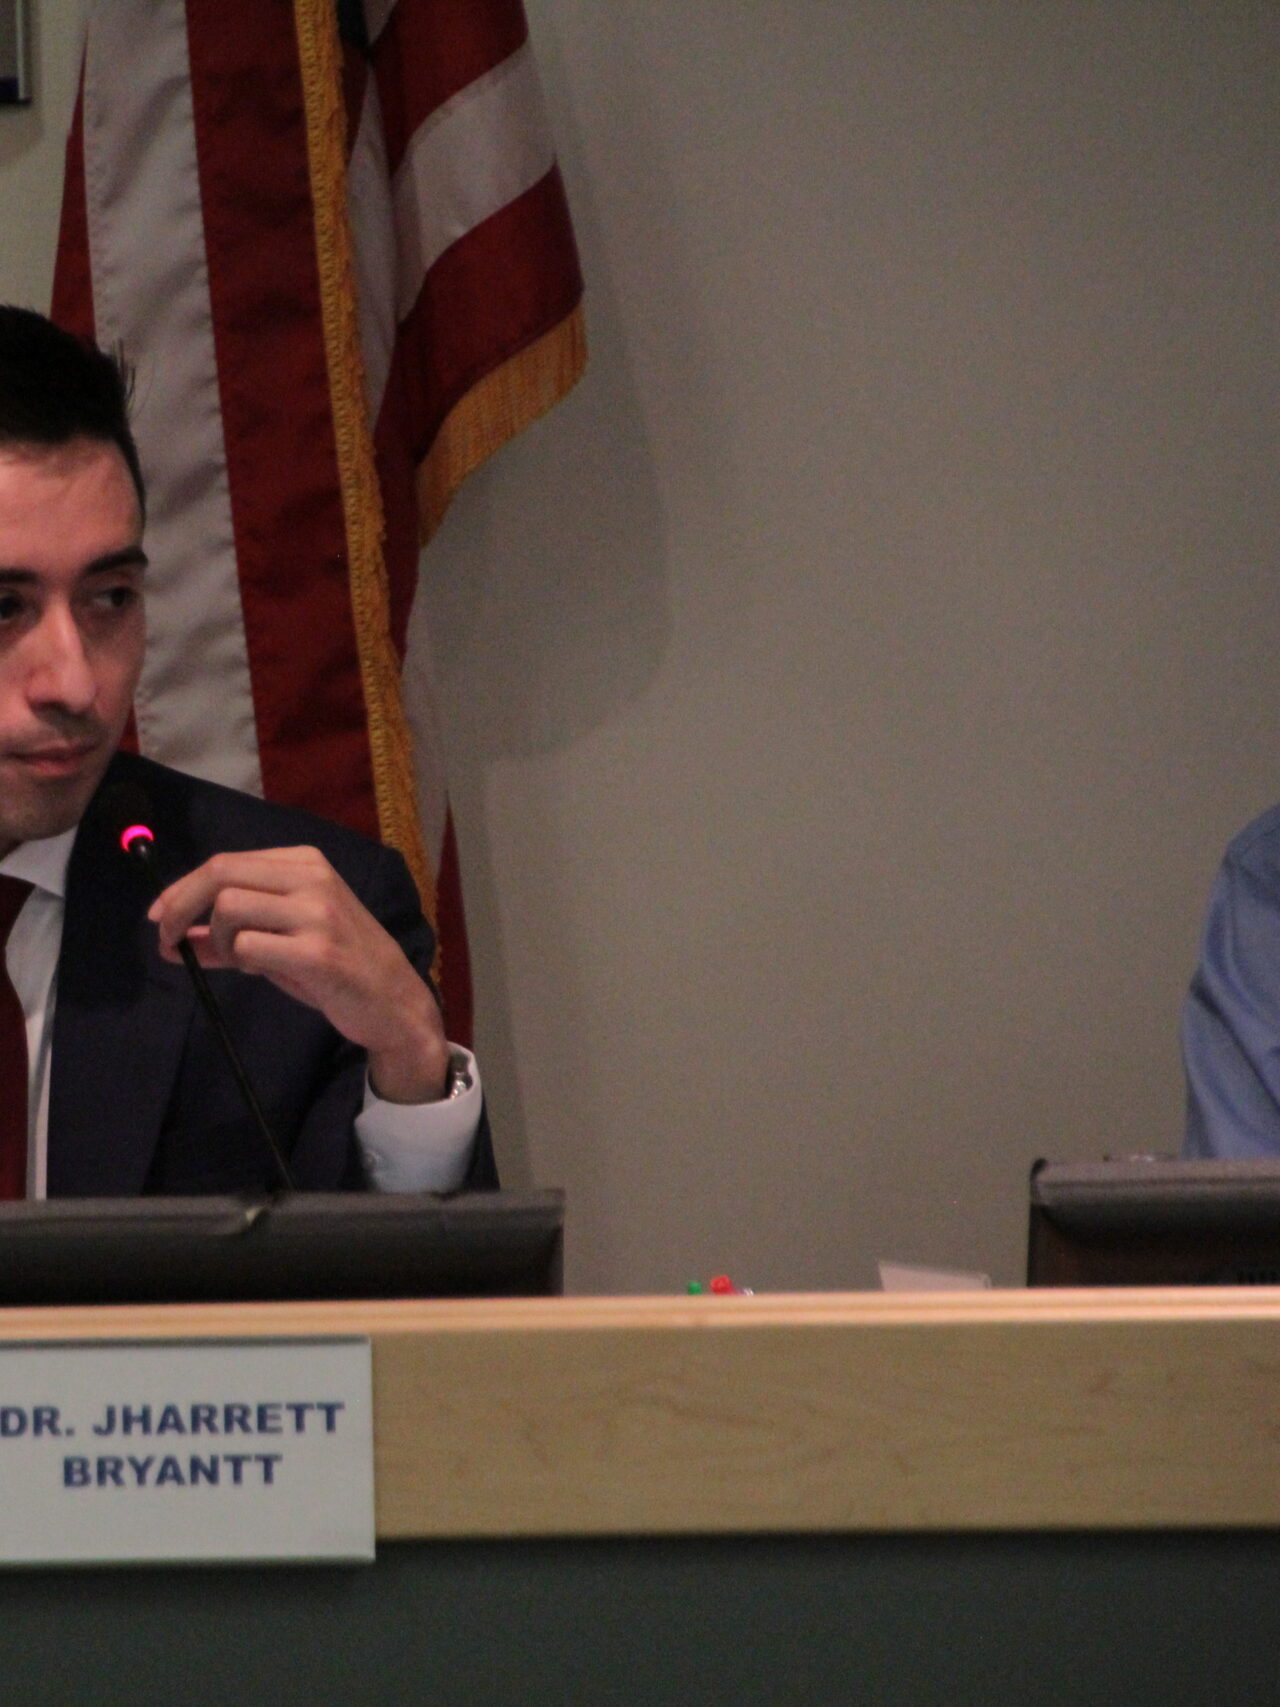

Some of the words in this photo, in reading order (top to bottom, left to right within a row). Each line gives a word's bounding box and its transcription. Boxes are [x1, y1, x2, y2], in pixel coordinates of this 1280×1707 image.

[0, 1405, 75, 1438] DR.
[92, 1402, 345, 1437] JHARRETT
[63, 1454, 283, 1488] BRYANTT
